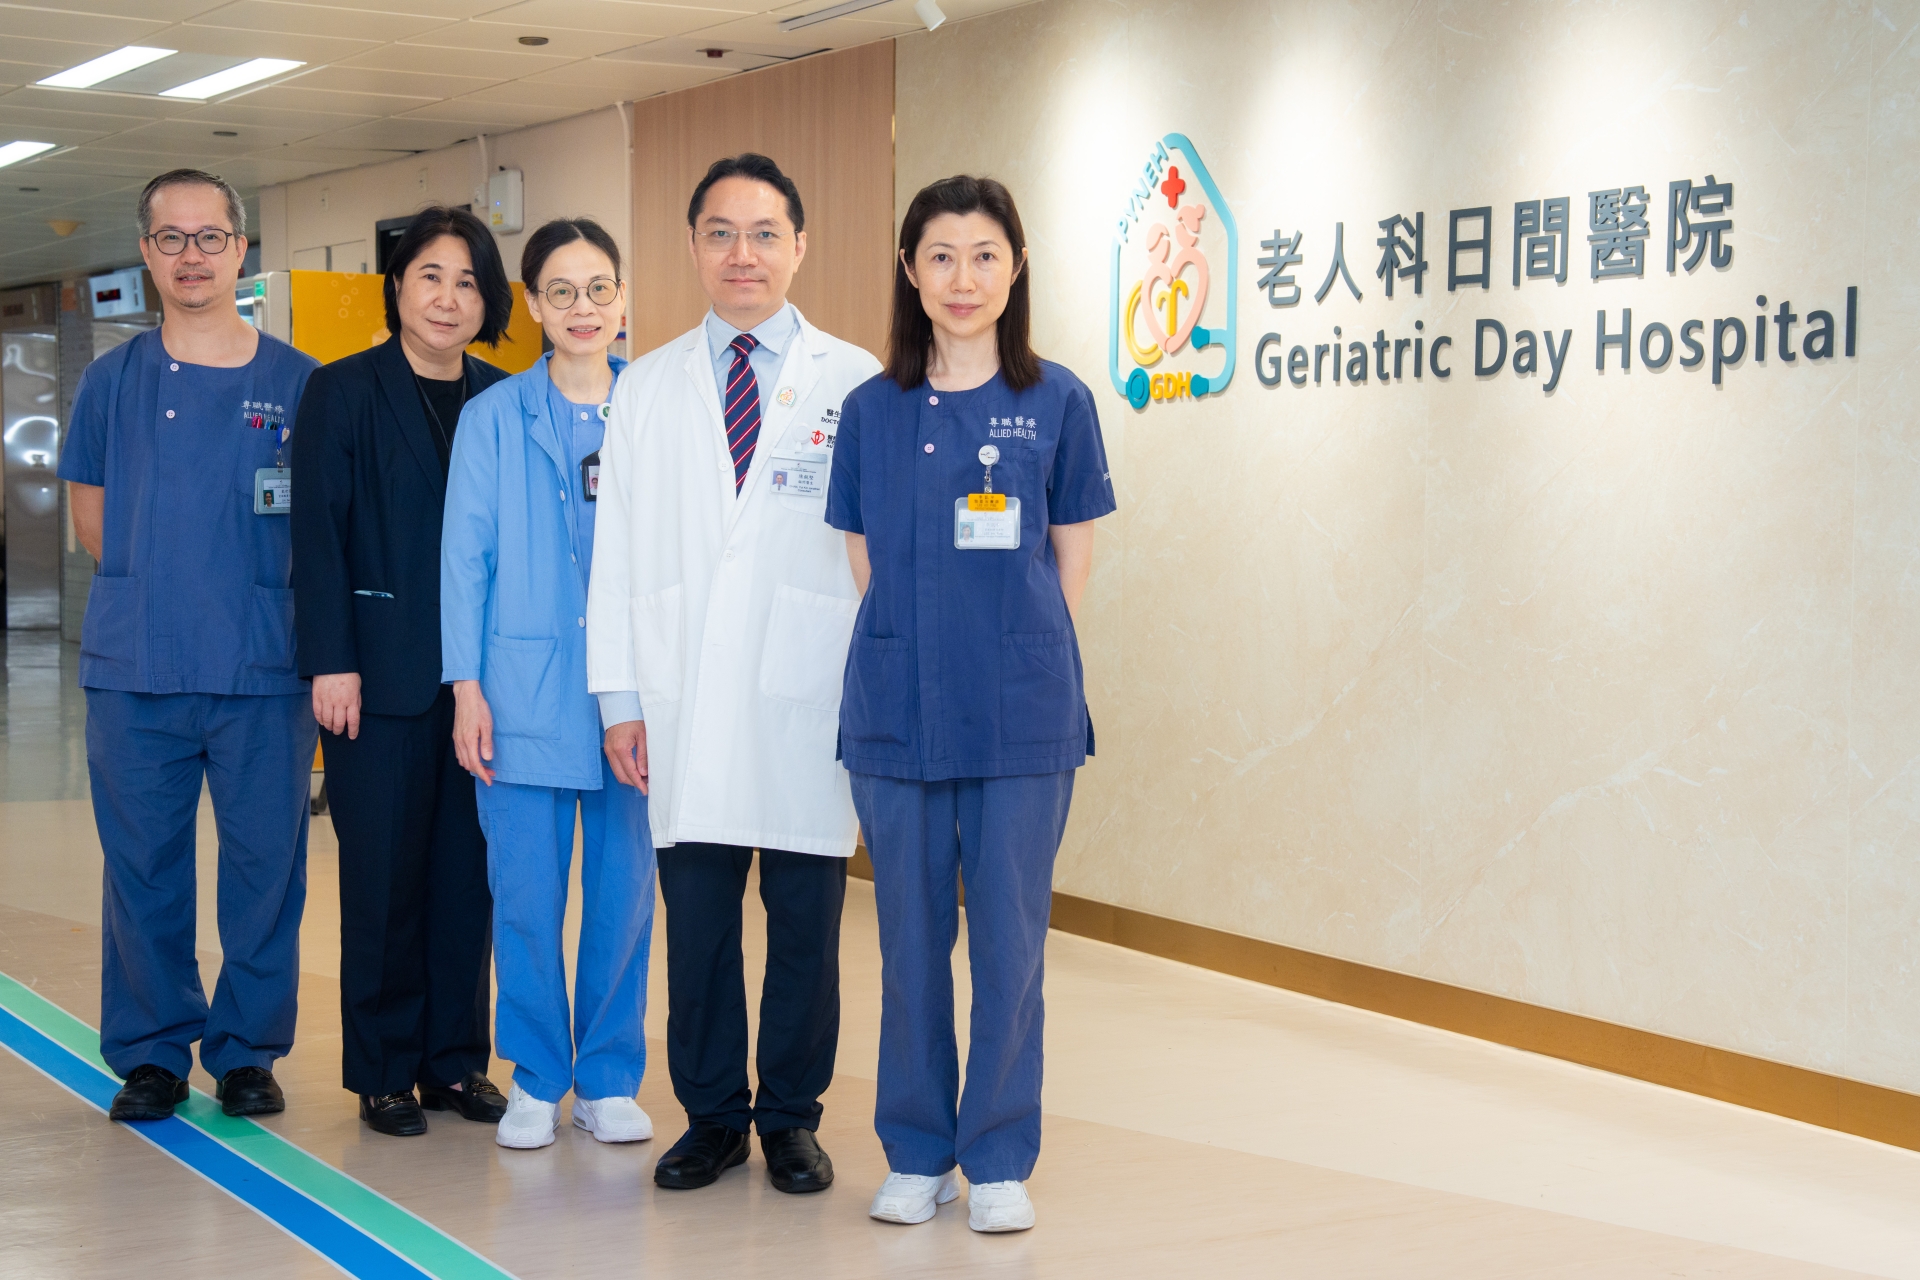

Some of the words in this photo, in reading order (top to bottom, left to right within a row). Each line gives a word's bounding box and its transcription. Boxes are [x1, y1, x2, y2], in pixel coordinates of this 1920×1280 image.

[1116, 141, 1169, 243] PYNEH
[1256, 174, 1734, 306] 老人科日間醫院
[1254, 319, 1453, 387] Geriatric
[1474, 317, 1573, 393] Day
[1597, 285, 1858, 384] Hospital
[1149, 371, 1192, 400] GDH
[988, 415, 1037, 429] 專職醫療
[989, 428, 1011, 438] ALLIED
[1012, 427, 1037, 441] HEALTH
